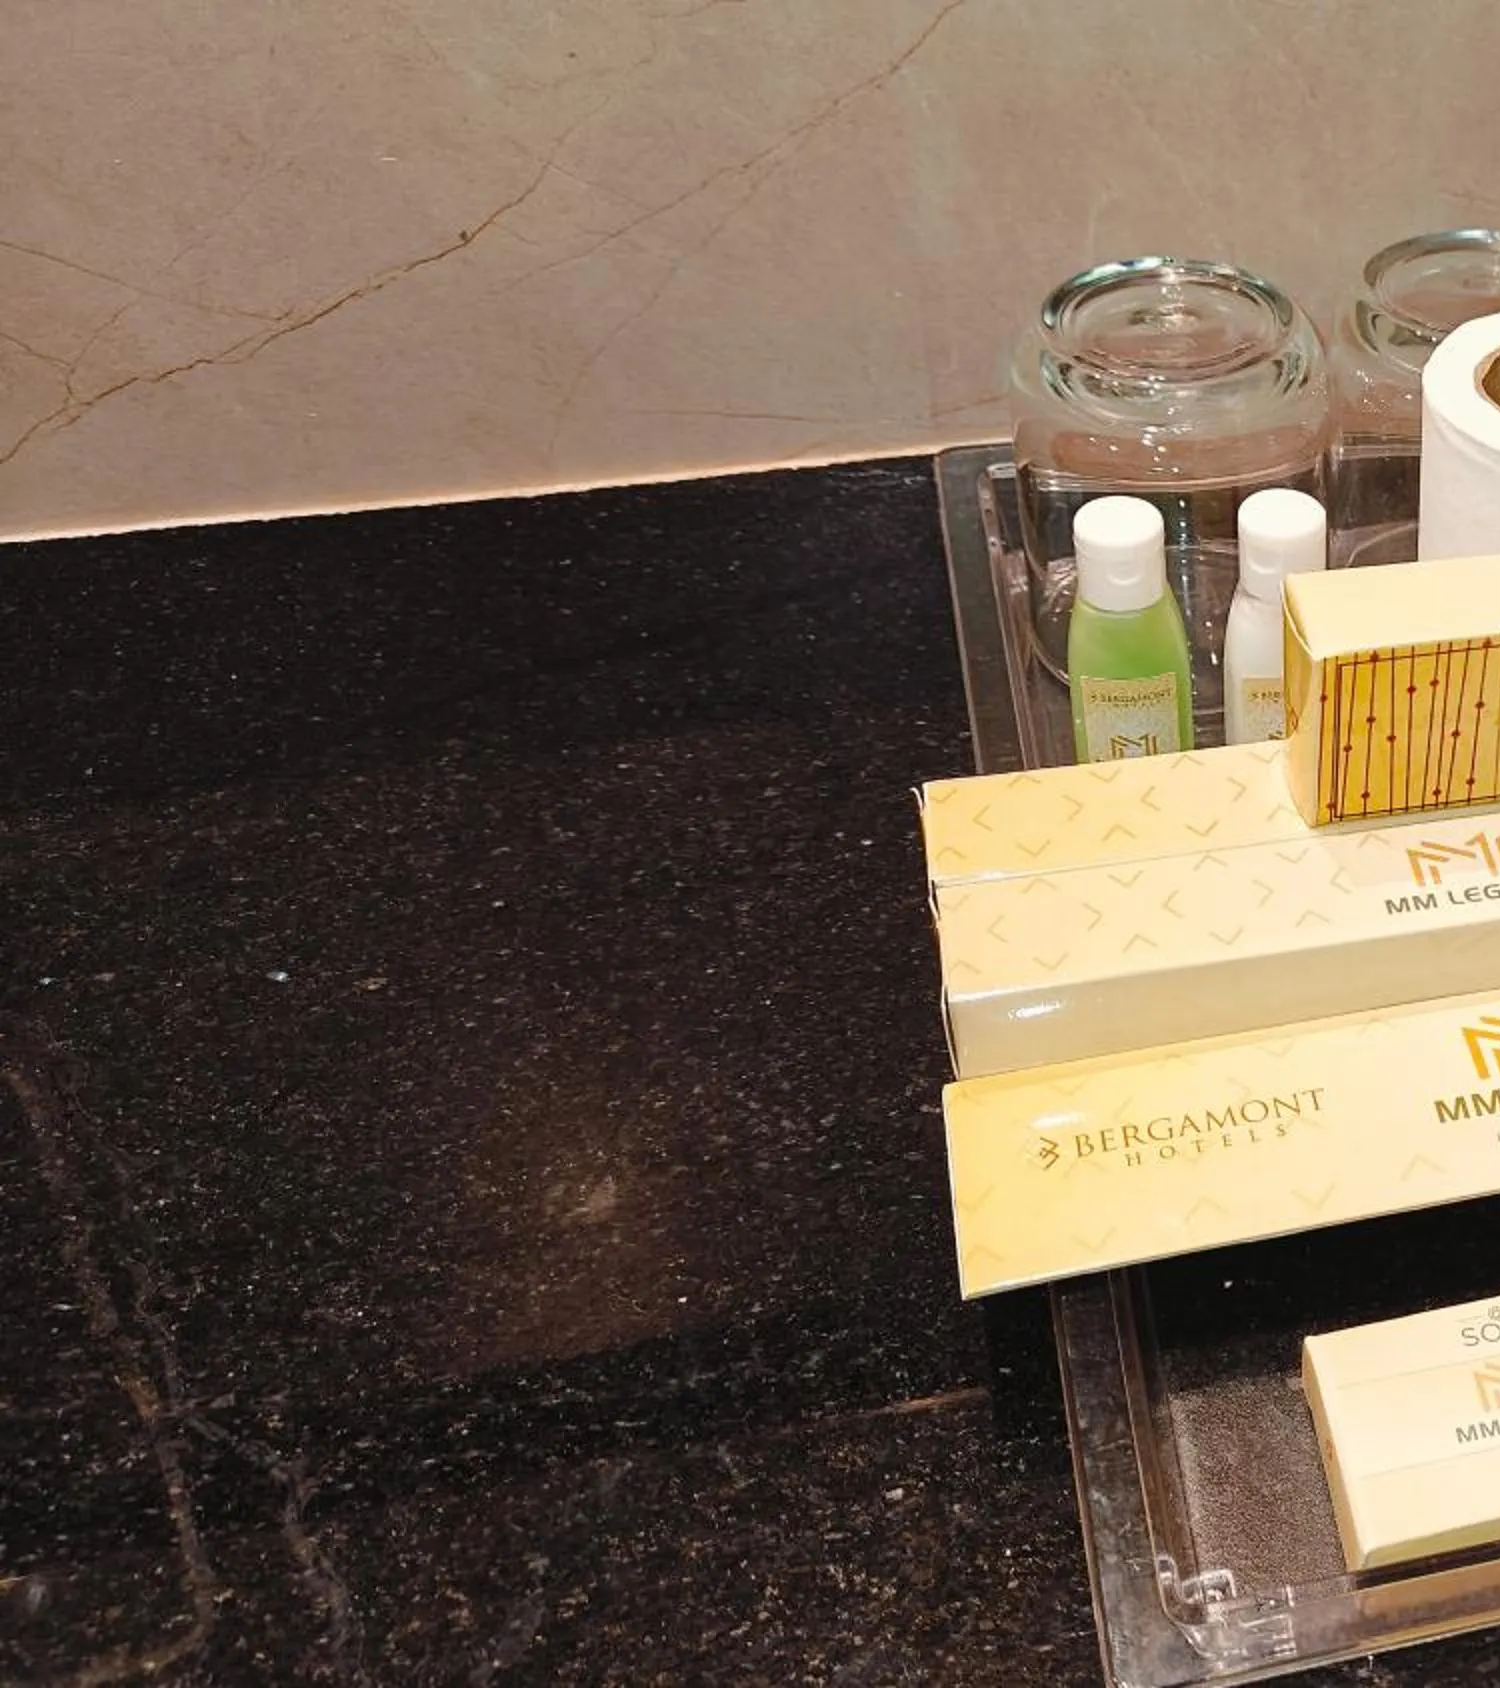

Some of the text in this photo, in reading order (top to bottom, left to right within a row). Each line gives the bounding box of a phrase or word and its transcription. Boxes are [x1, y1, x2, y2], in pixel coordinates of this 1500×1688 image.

[1385, 893, 1438, 916] MM
[1075, 1087, 1326, 1158] BERGAMONT
[1126, 1124, 1288, 1167] HOTELS
